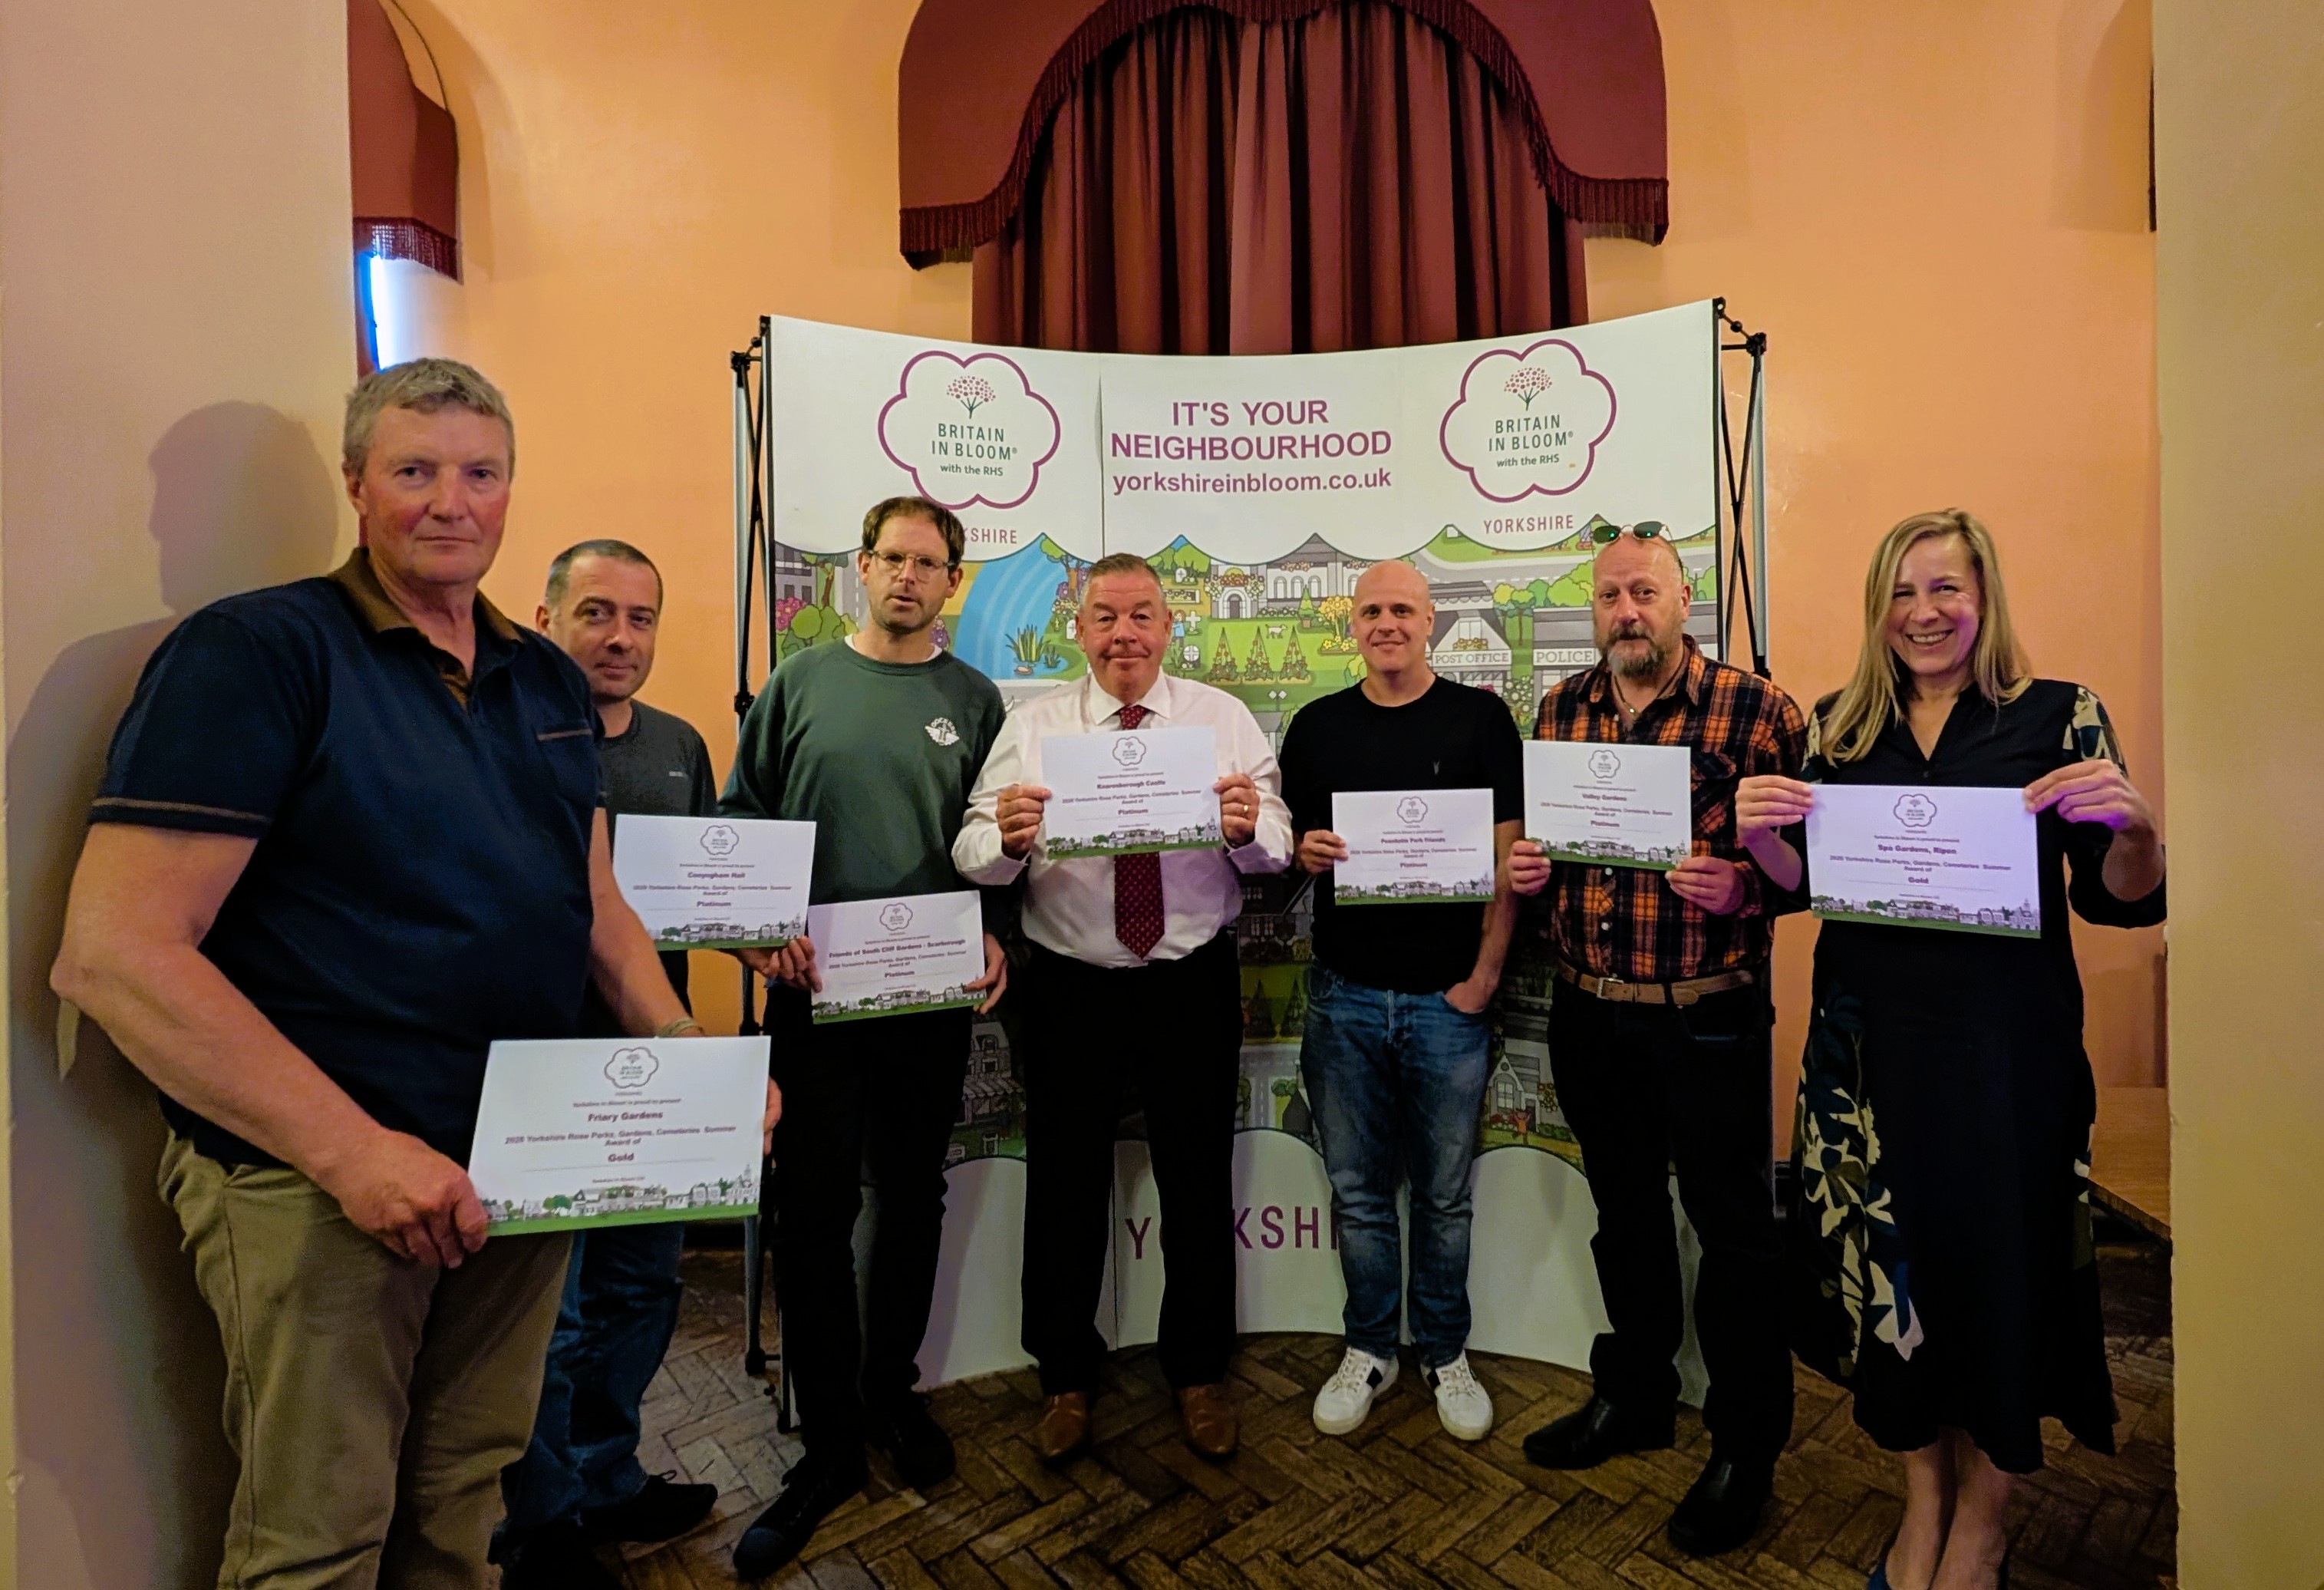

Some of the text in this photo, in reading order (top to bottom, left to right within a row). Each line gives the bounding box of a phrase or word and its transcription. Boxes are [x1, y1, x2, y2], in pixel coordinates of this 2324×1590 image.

[1172, 399, 1329, 427] IT'S YOUR
[1495, 414, 1561, 434] BRITAIN
[938, 423, 1004, 442] BRITAIN
[931, 440, 948, 455] IN
[1112, 430, 1392, 461] NEIGHBOURHOOD
[1488, 437, 1505, 451] IN
[1496, 454, 1560, 467] with the RHS
[940, 464, 1004, 477] with the RHS
[1113, 468, 1392, 496] yorkshireinbloom.co.uk
[1484, 514, 1574, 534] YORKSHIRE
[1435, 652, 1509, 665] POST OFFICE
[1536, 650, 1593, 664] POLICE
[588, 1111, 663, 1123] Friary Gardens
[608, 1153, 635, 1162] Gold
